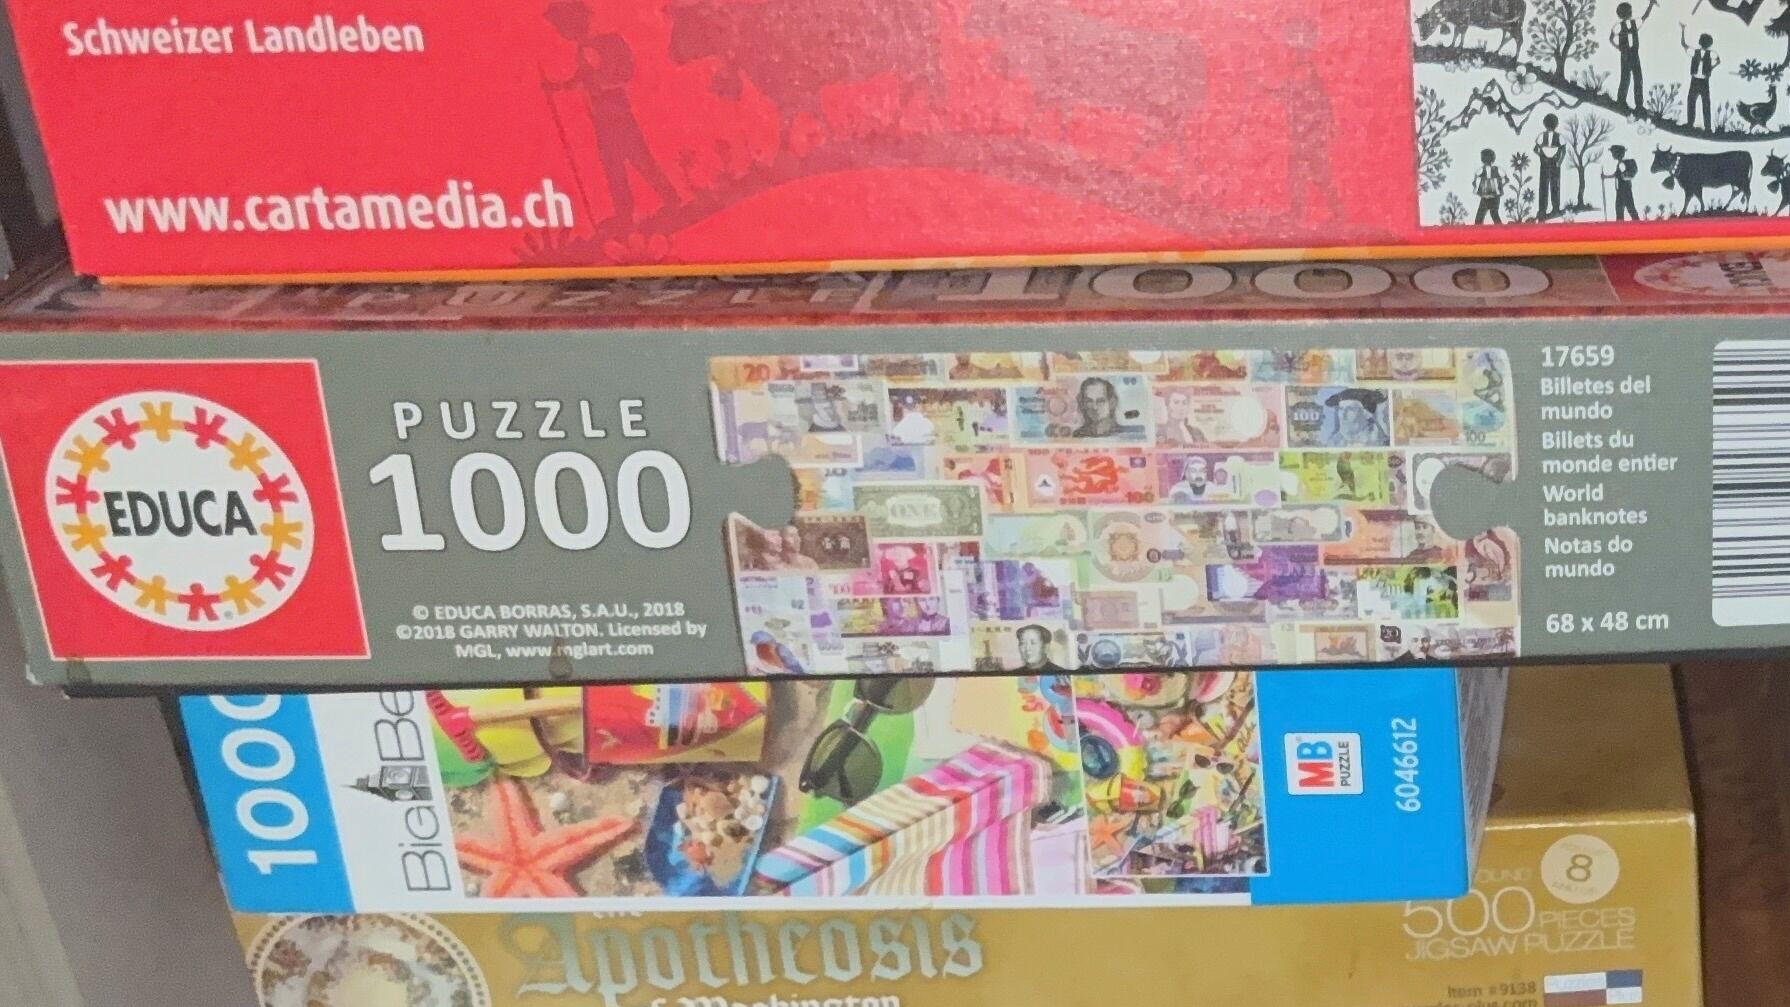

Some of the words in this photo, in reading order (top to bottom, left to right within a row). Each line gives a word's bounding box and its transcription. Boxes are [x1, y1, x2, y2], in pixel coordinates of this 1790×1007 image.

[62, 19, 235, 57] Schweizer
[245, 20, 425, 54] Landleben
[104, 179, 574, 235] www.cartamedia.ch
[1541, 345, 1614, 367] 17659
[1541, 376, 1614, 395] Billetes
[1620, 375, 1651, 394] del
[393, 399, 647, 440] PUZZLE
[1541, 402, 1613, 420] mundo
[1542, 432, 1603, 450] Billets
[1608, 429, 1634, 448] du
[1542, 454, 1613, 474] monde
[1618, 454, 1678, 472] entier
[368, 449, 692, 551] 1000
[1543, 483, 1603, 502] World
[104, 489, 258, 538] EDUCA
[1544, 507, 1648, 526] banknotes
[1545, 537, 1602, 555] Notas
[1607, 535, 1633, 553] do
[1545, 560, 1615, 578] mundo
[434, 605, 497, 620] EDUCA
[499, 604, 577, 621] BORRAS,
[581, 603, 640, 619] S.A.U.,
[643, 602, 686, 617] 2018
[1546, 614, 1574, 633] 68
[1581, 618, 1594, 632] x
[1600, 611, 1629, 631] 48
[1636, 614, 1669, 629] cm
[395, 624, 455, 640] ©2018
[459, 624, 519, 639] GARRY
[523, 622, 604, 638] WALTON.
[608, 620, 682, 637] Licensed
[686, 620, 707, 638] by
[455, 644, 501, 660] MGL,
[505, 641, 654, 659] www.mglart.com
[374, 692, 424, 761] Be
[1297, 741, 1335, 788] MB
[1338, 741, 1351, 787] PUZZLE
[1391, 717, 1421, 812] 6046612
[1566, 854, 1593, 882] 8
[1403, 886, 1535, 938] 500
[1539, 907, 1636, 929] PIECES
[1406, 934, 1519, 961] JIGSAW
[1524, 927, 1635, 954] PUZZLE
[1448, 984, 1483, 999] Item
